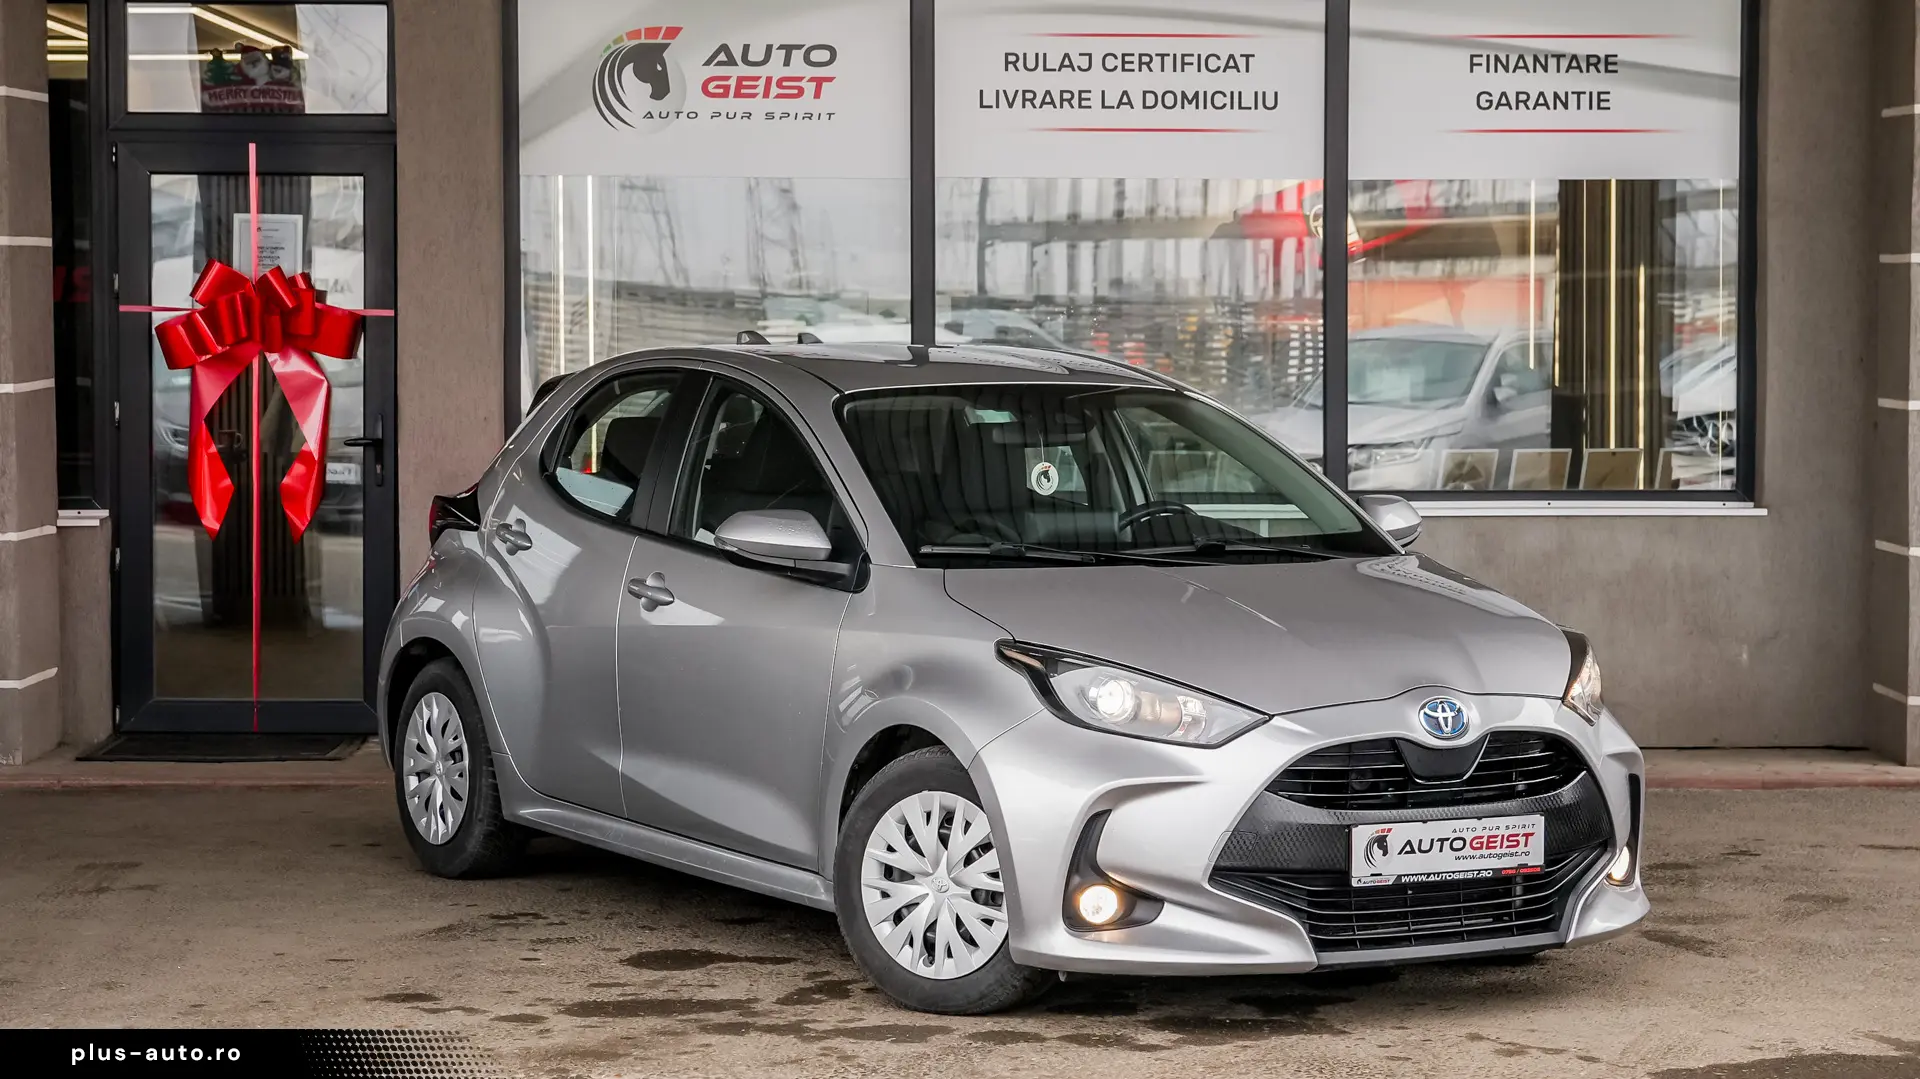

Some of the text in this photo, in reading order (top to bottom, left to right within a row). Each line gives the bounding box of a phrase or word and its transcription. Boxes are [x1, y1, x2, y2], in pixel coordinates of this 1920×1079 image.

[701, 43, 838, 67] AUTO
[1004, 52, 1256, 73] RULAJ CERTIFICAT
[1469, 54, 1619, 74] FINANTARE
[208, 88, 246, 101] MERRY
[701, 75, 837, 99] GEIST
[979, 90, 1279, 110] LIVRARE LA DOMICILIU
[1476, 91, 1611, 110] GARANTIE
[642, 111, 836, 121] AUTO PUR SPIRIT
[1454, 850, 1531, 861] www.autogeist.ro
[1401, 870, 1493, 883] WWW.AUTOGEIST.RO
